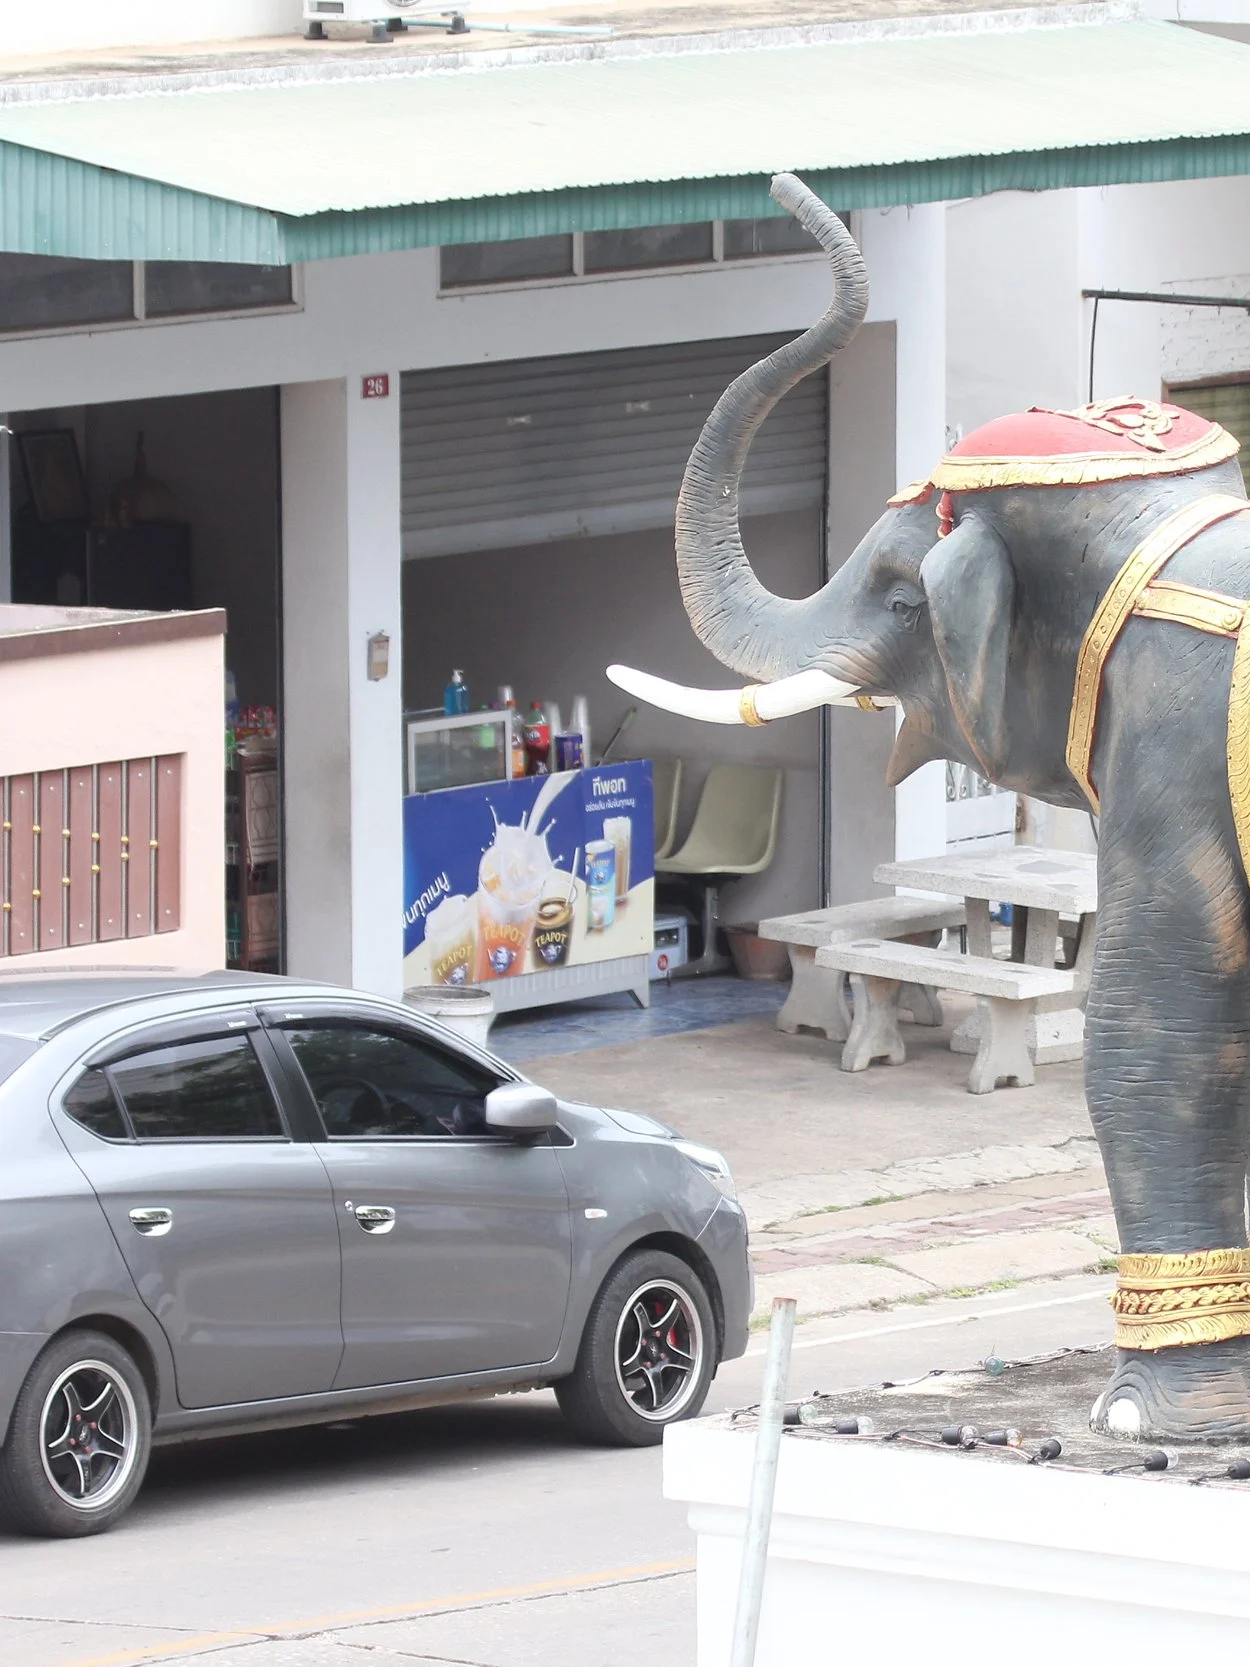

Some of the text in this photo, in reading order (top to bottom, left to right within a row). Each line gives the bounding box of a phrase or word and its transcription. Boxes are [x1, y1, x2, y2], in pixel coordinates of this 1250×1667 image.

[367, 377, 384, 395] 26
[592, 776, 626, 796] ทีพอท
[482, 923, 526, 945] TEAPOT
[534, 931, 568, 948] TEAPOT
[436, 945, 473, 977] TEAPOT
